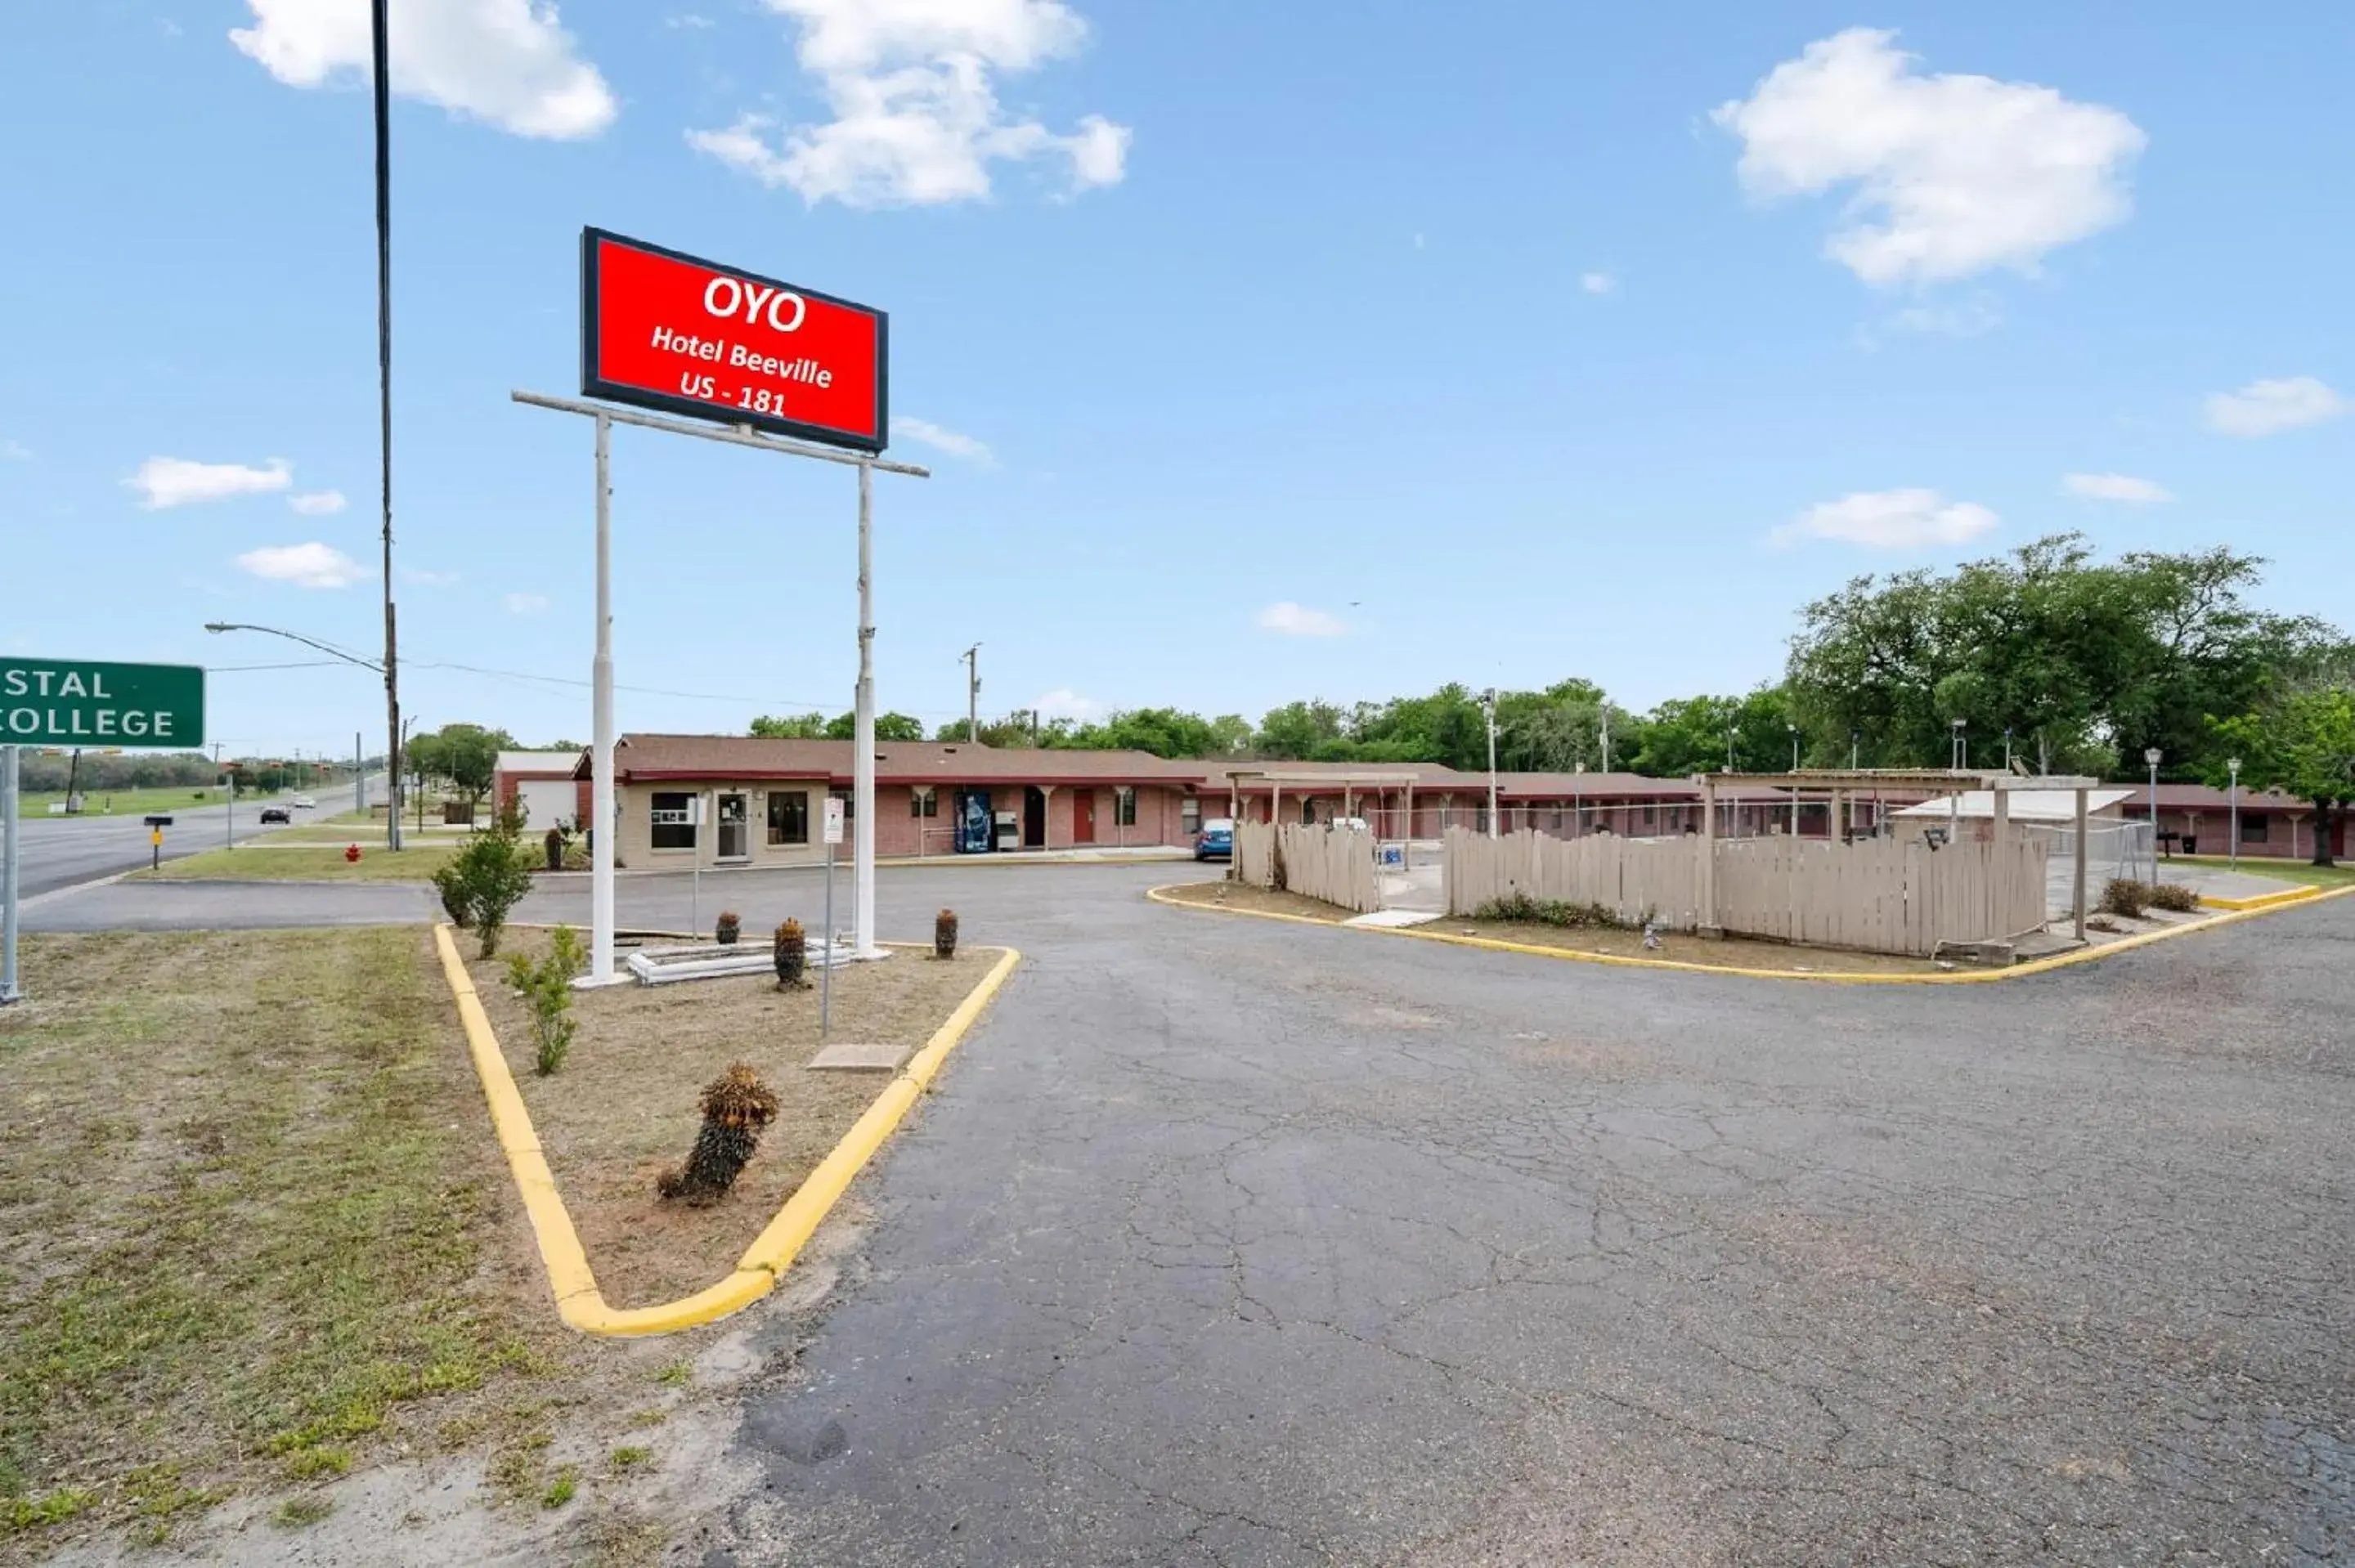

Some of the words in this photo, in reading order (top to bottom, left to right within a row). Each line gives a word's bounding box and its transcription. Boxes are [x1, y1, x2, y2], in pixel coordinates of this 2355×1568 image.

[704, 276, 805, 332] OYO
[652, 326, 724, 362] Hotel
[729, 344, 832, 388] Beeville
[680, 372, 715, 400] US
[738, 388, 784, 418] 181
[5, 670, 111, 698] STAL
[0, 707, 173, 736] OLLEGE
